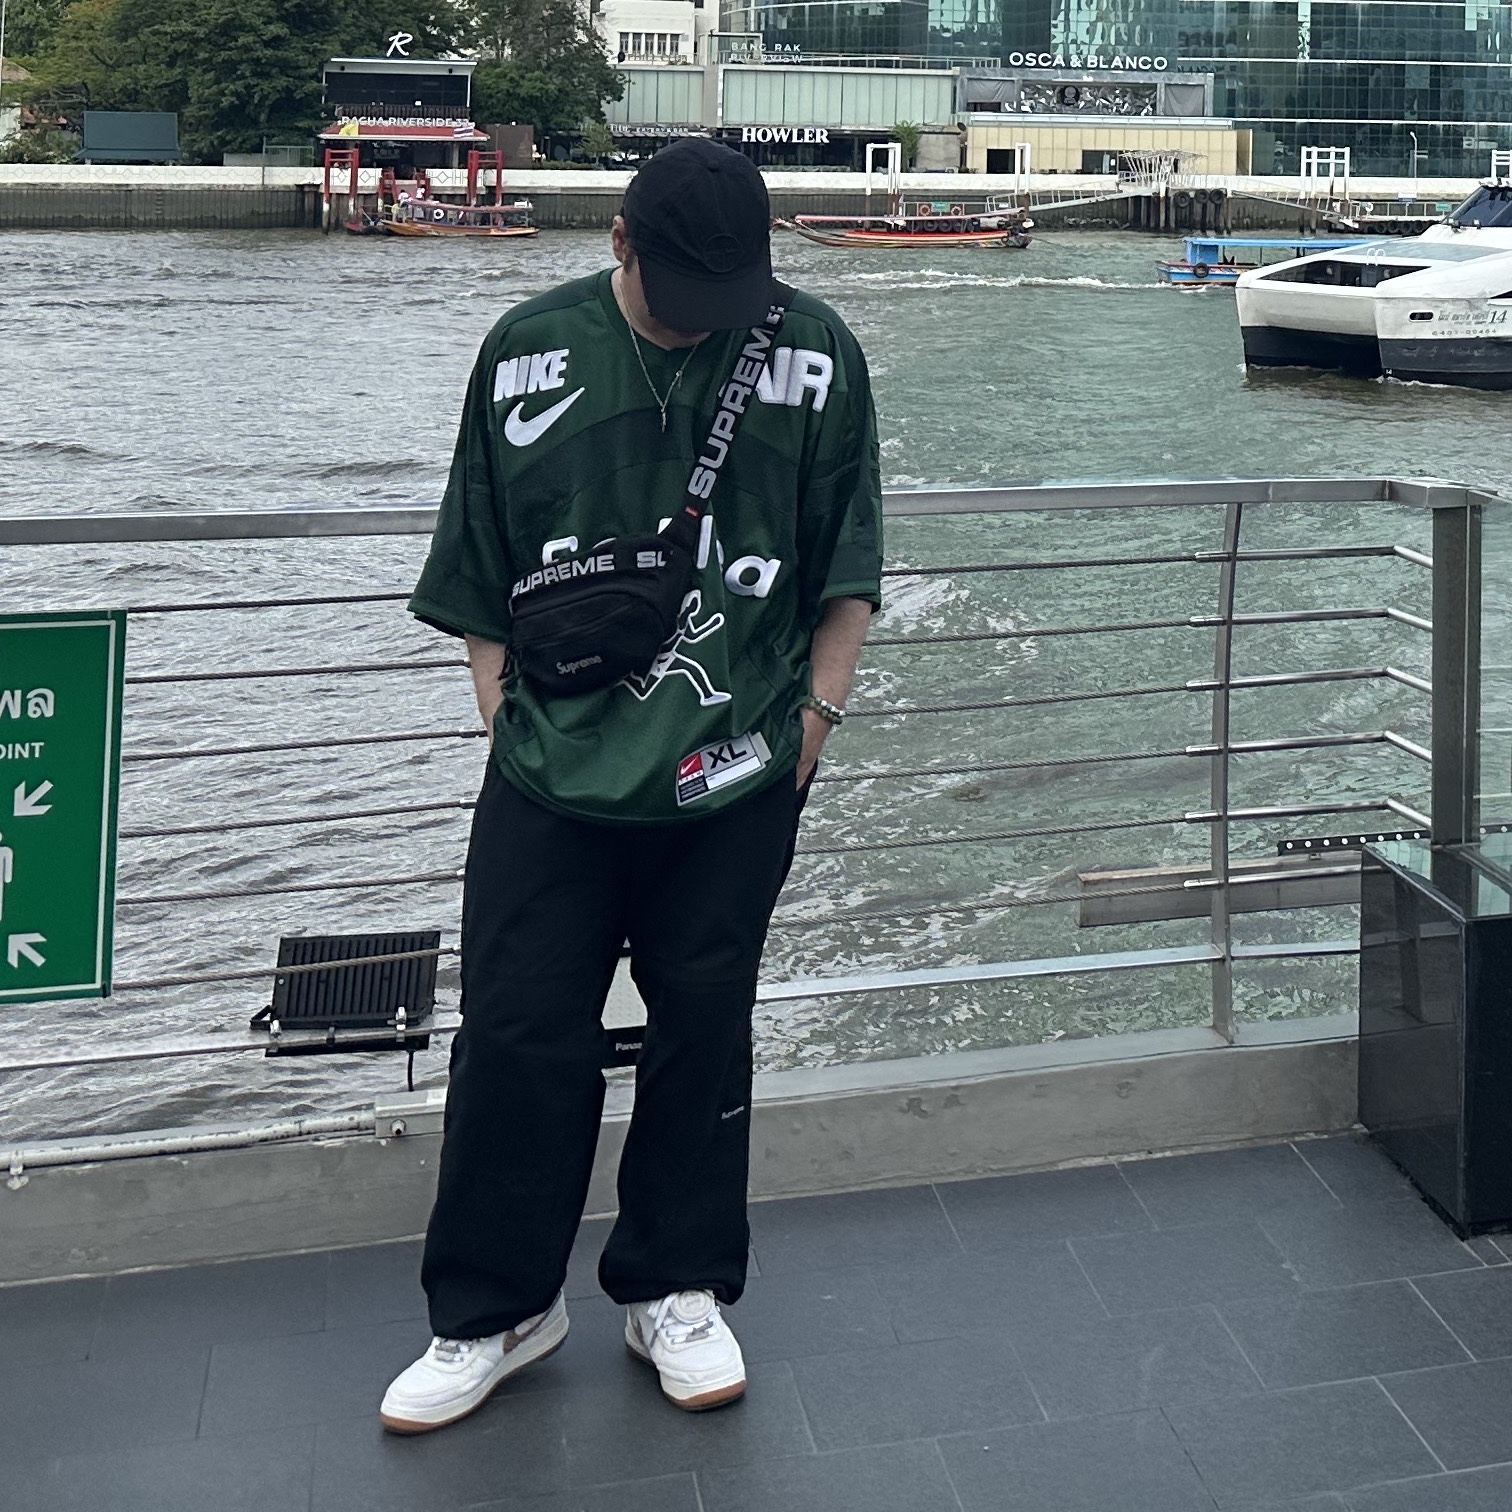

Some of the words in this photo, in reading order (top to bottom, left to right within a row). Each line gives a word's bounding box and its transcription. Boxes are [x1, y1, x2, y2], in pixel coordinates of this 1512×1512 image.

[386, 31, 413, 57] R
[731, 41, 767, 52] BANG
[774, 43, 801, 52] RAK
[1009, 51, 1066, 68] OSCA
[1087, 55, 1168, 71] BLANCO
[388, 117, 453, 127] RIVERSIDE
[741, 127, 830, 144] HOWLER
[493, 348, 571, 403] NIKE
[511, 553, 615, 598] SUPREME
[556, 654, 602, 676] Supreme
[706, 742, 748, 770] XL
